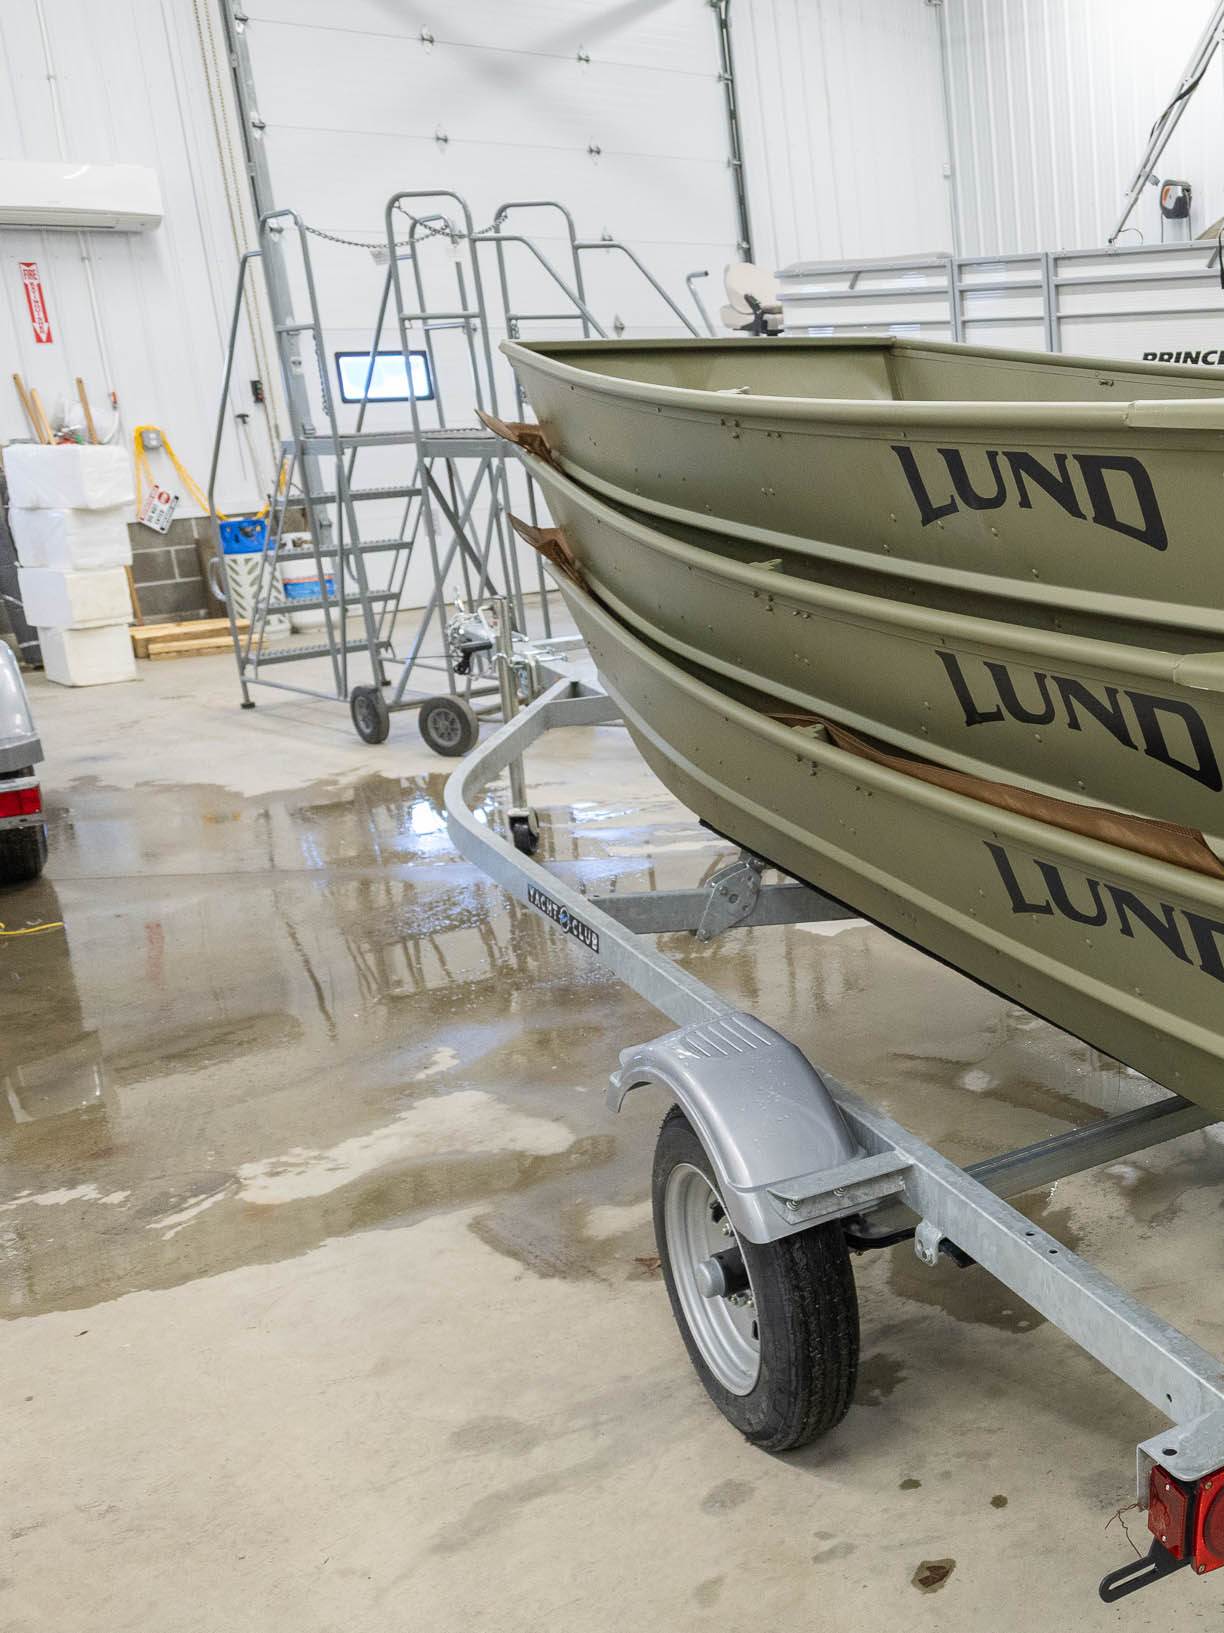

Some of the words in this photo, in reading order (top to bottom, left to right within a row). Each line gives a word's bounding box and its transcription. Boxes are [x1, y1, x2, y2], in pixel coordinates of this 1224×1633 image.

[890, 444, 1169, 552] LUND
[935, 650, 1224, 793] LUND
[528, 886, 559, 921] YACHT
[571, 918, 599, 951] CLUB
